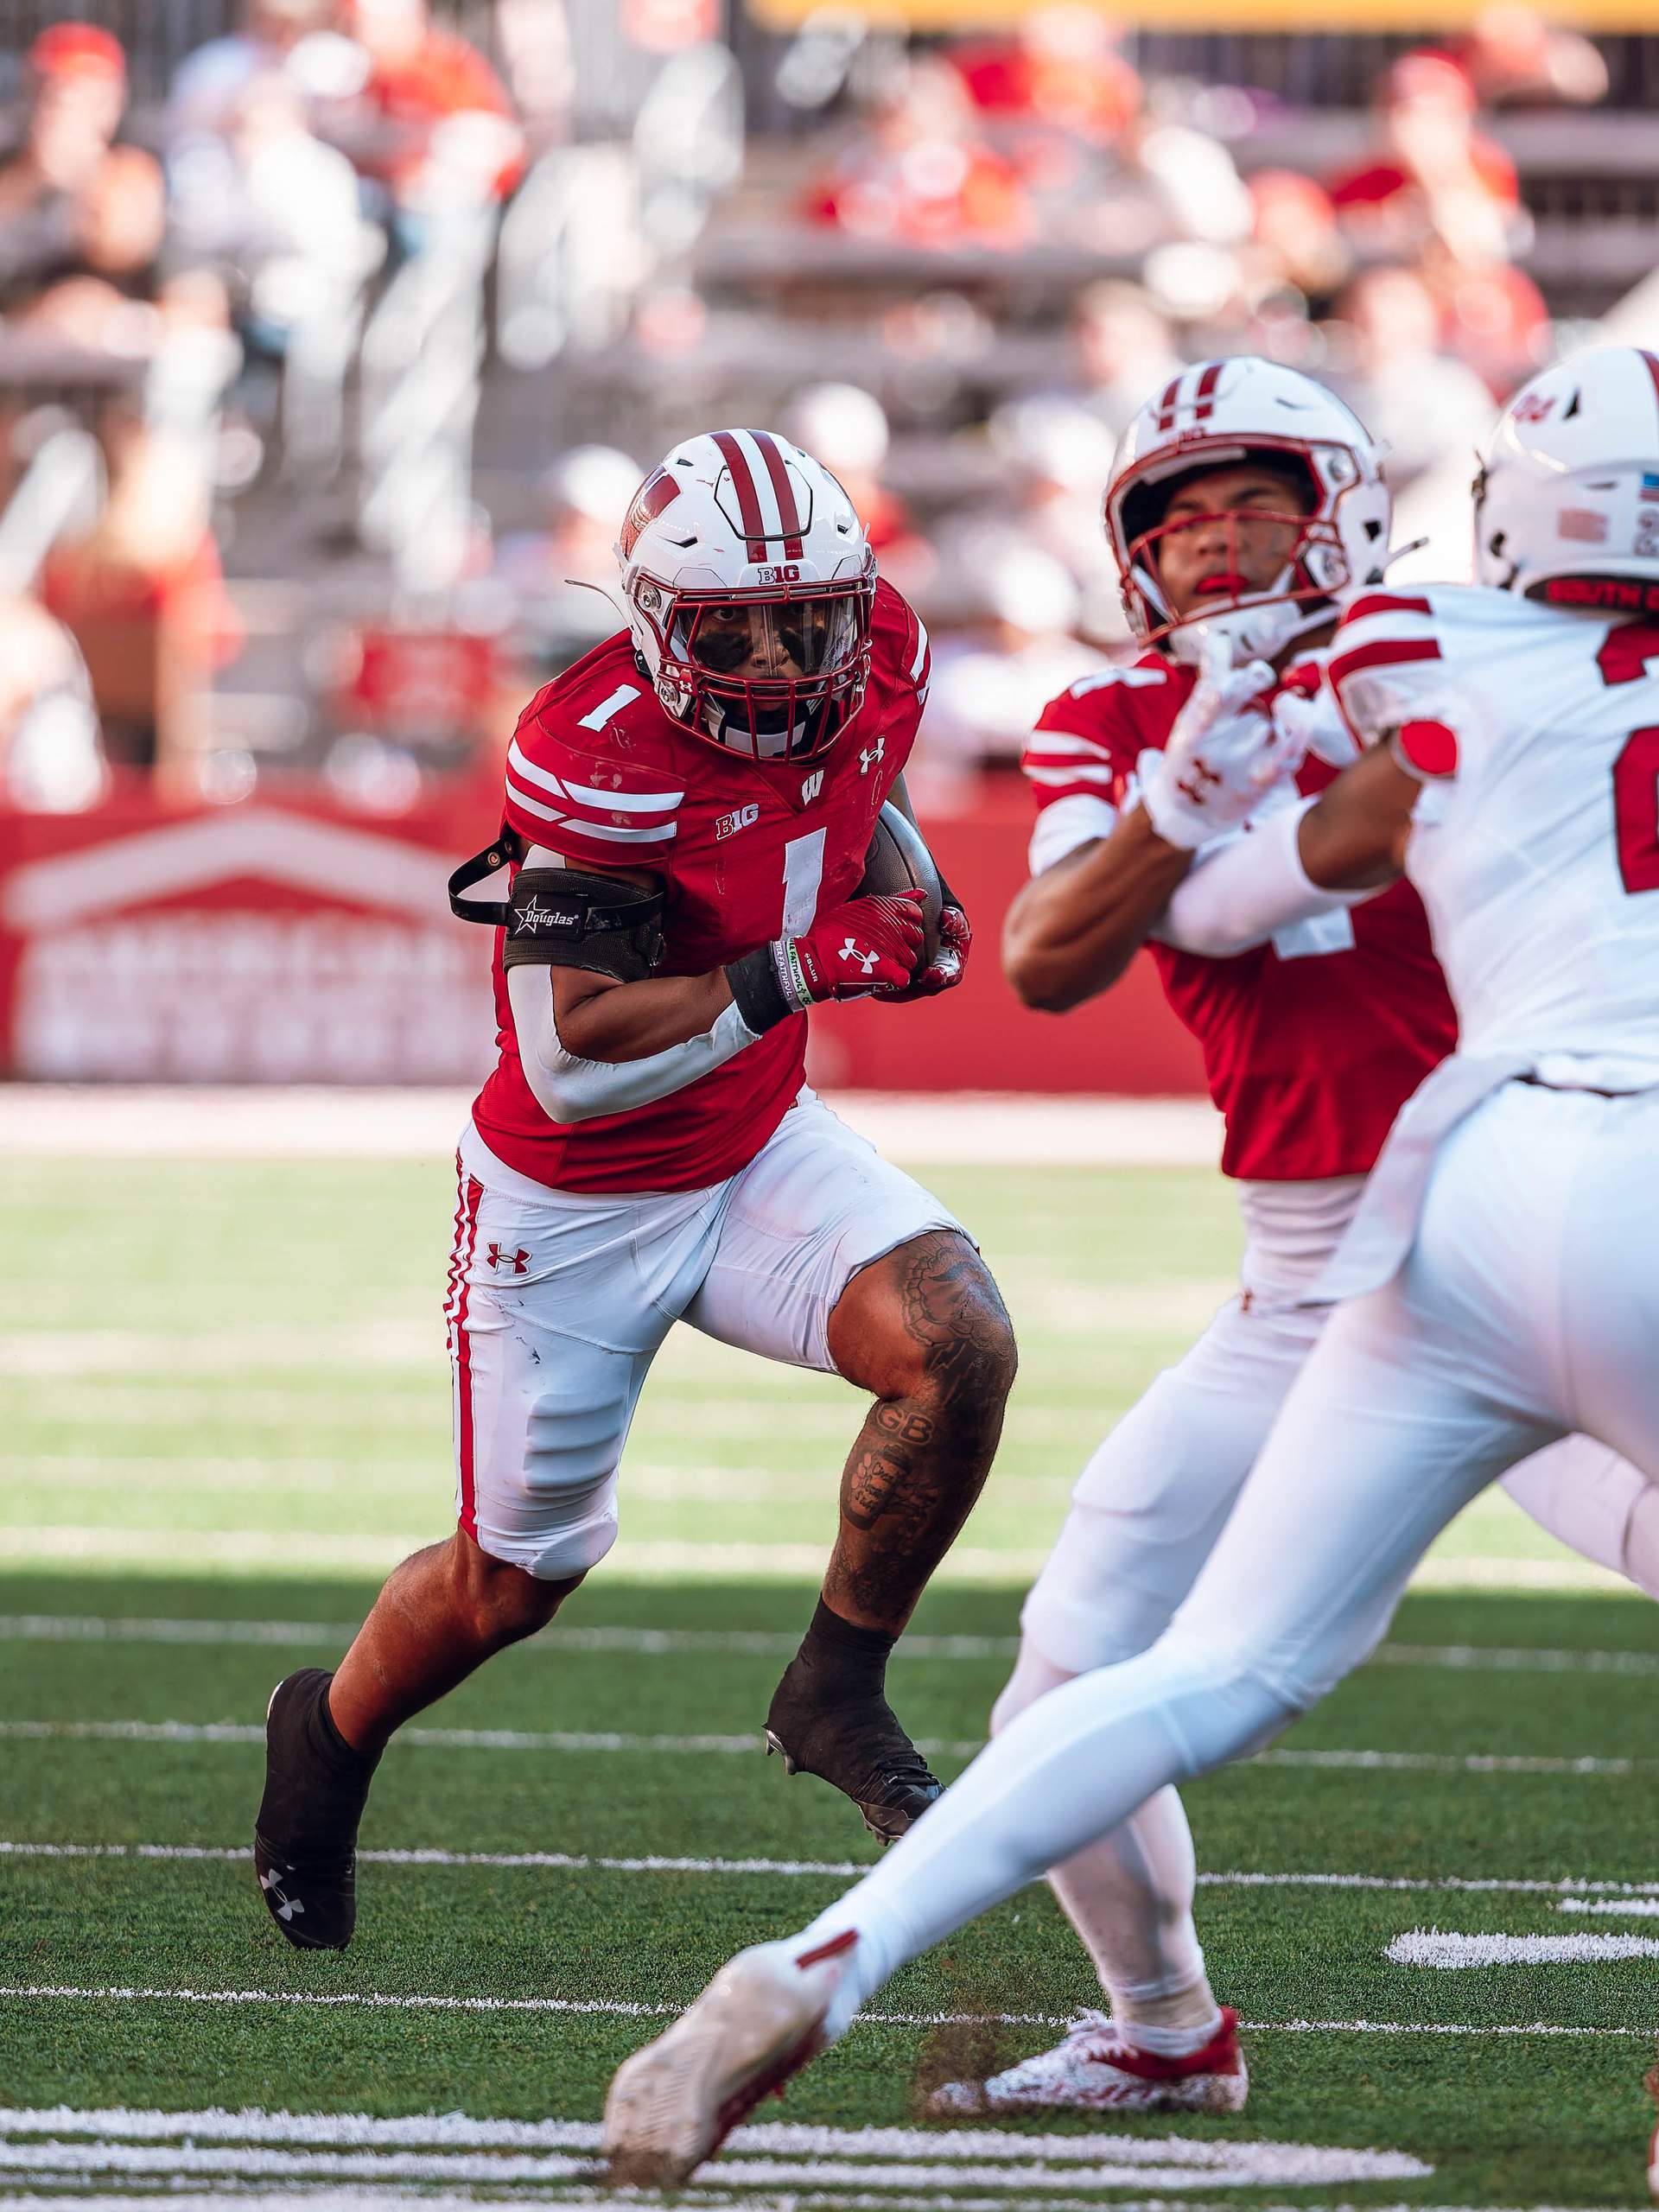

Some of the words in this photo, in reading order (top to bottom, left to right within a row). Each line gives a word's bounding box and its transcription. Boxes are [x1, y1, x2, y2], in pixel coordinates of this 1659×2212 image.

[577, 683, 641, 733] 1
[802, 769, 823, 806] W
[779, 826, 827, 939] 1
[806, 957, 818, 982] BLUR
[876, 1403, 935, 1446] GB
